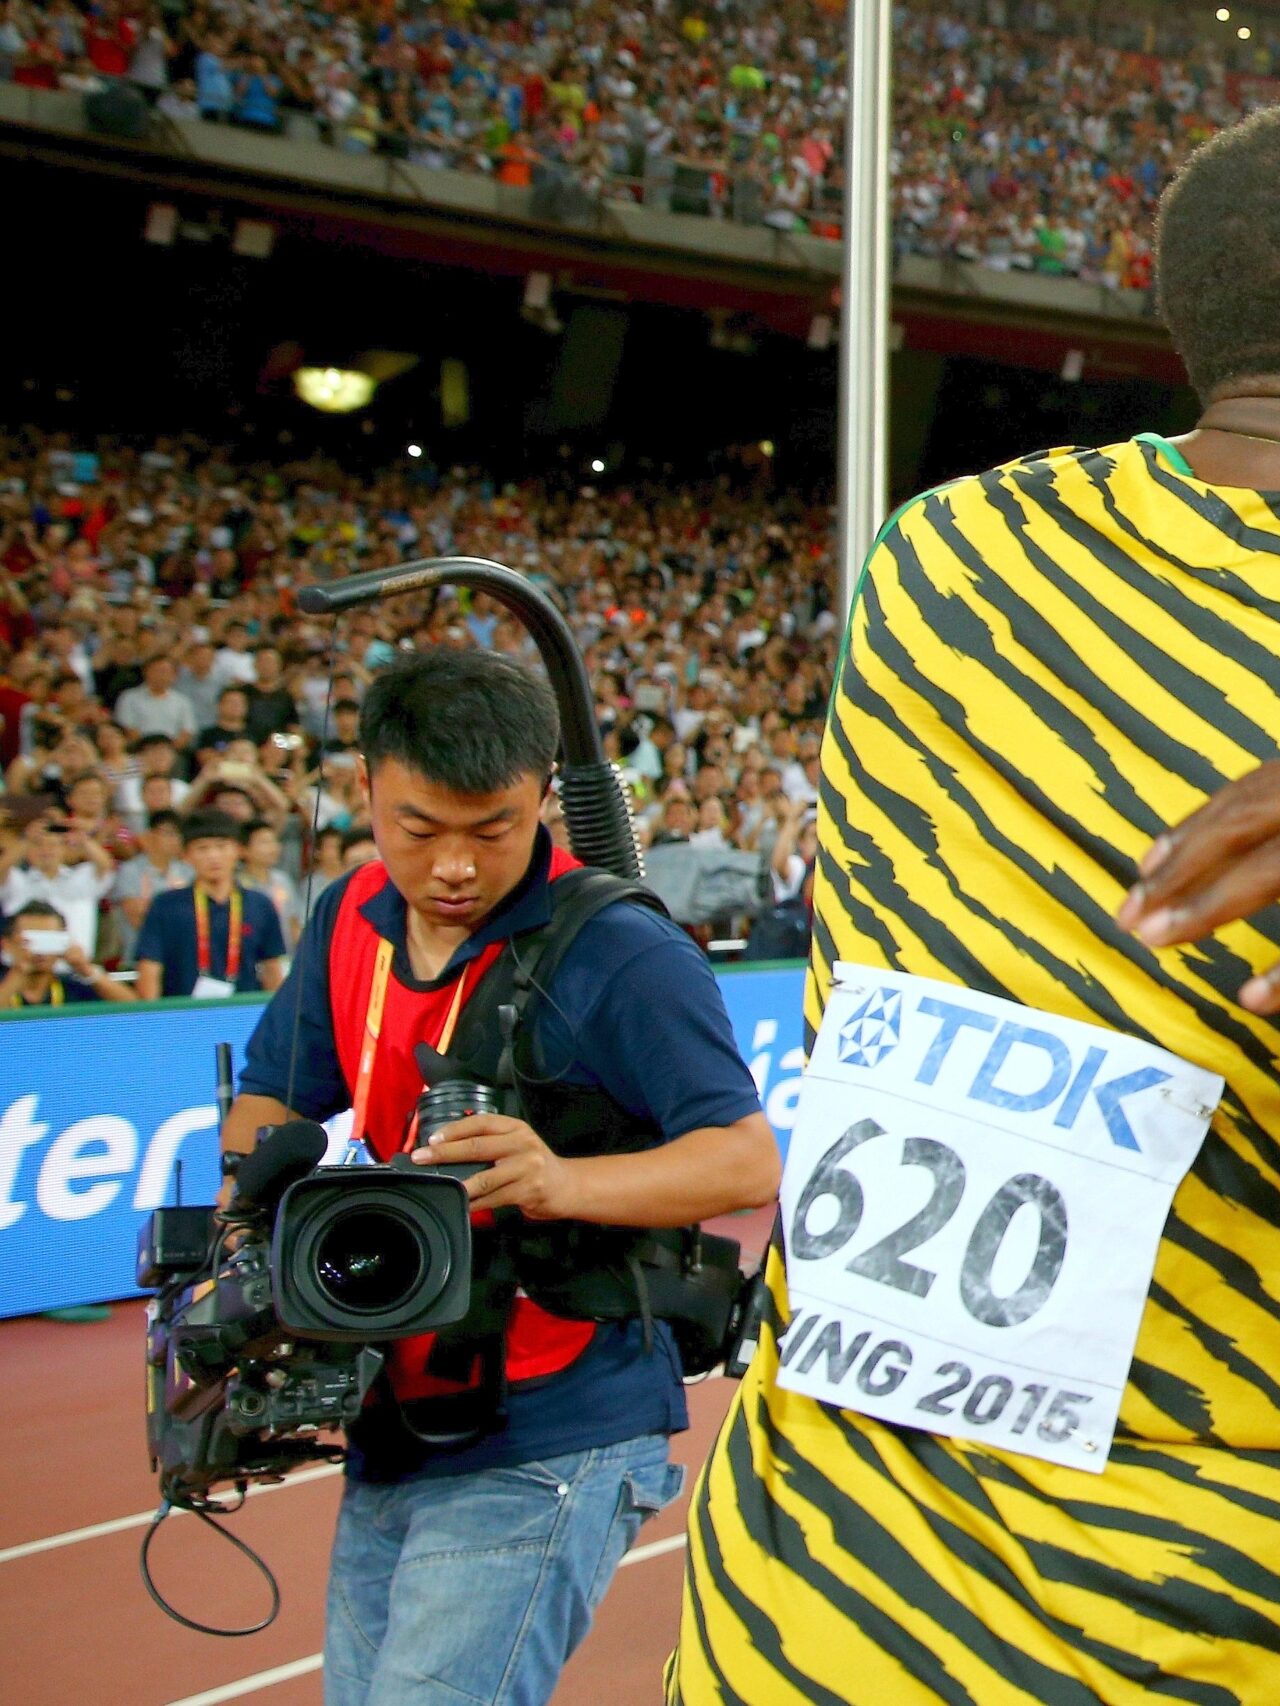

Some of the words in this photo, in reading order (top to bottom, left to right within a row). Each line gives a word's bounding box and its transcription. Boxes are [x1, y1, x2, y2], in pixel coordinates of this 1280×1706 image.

[915, 996, 1173, 1153] TDK
[790, 1117, 1069, 1328] 620
[915, 1361, 1094, 1443] 2015
